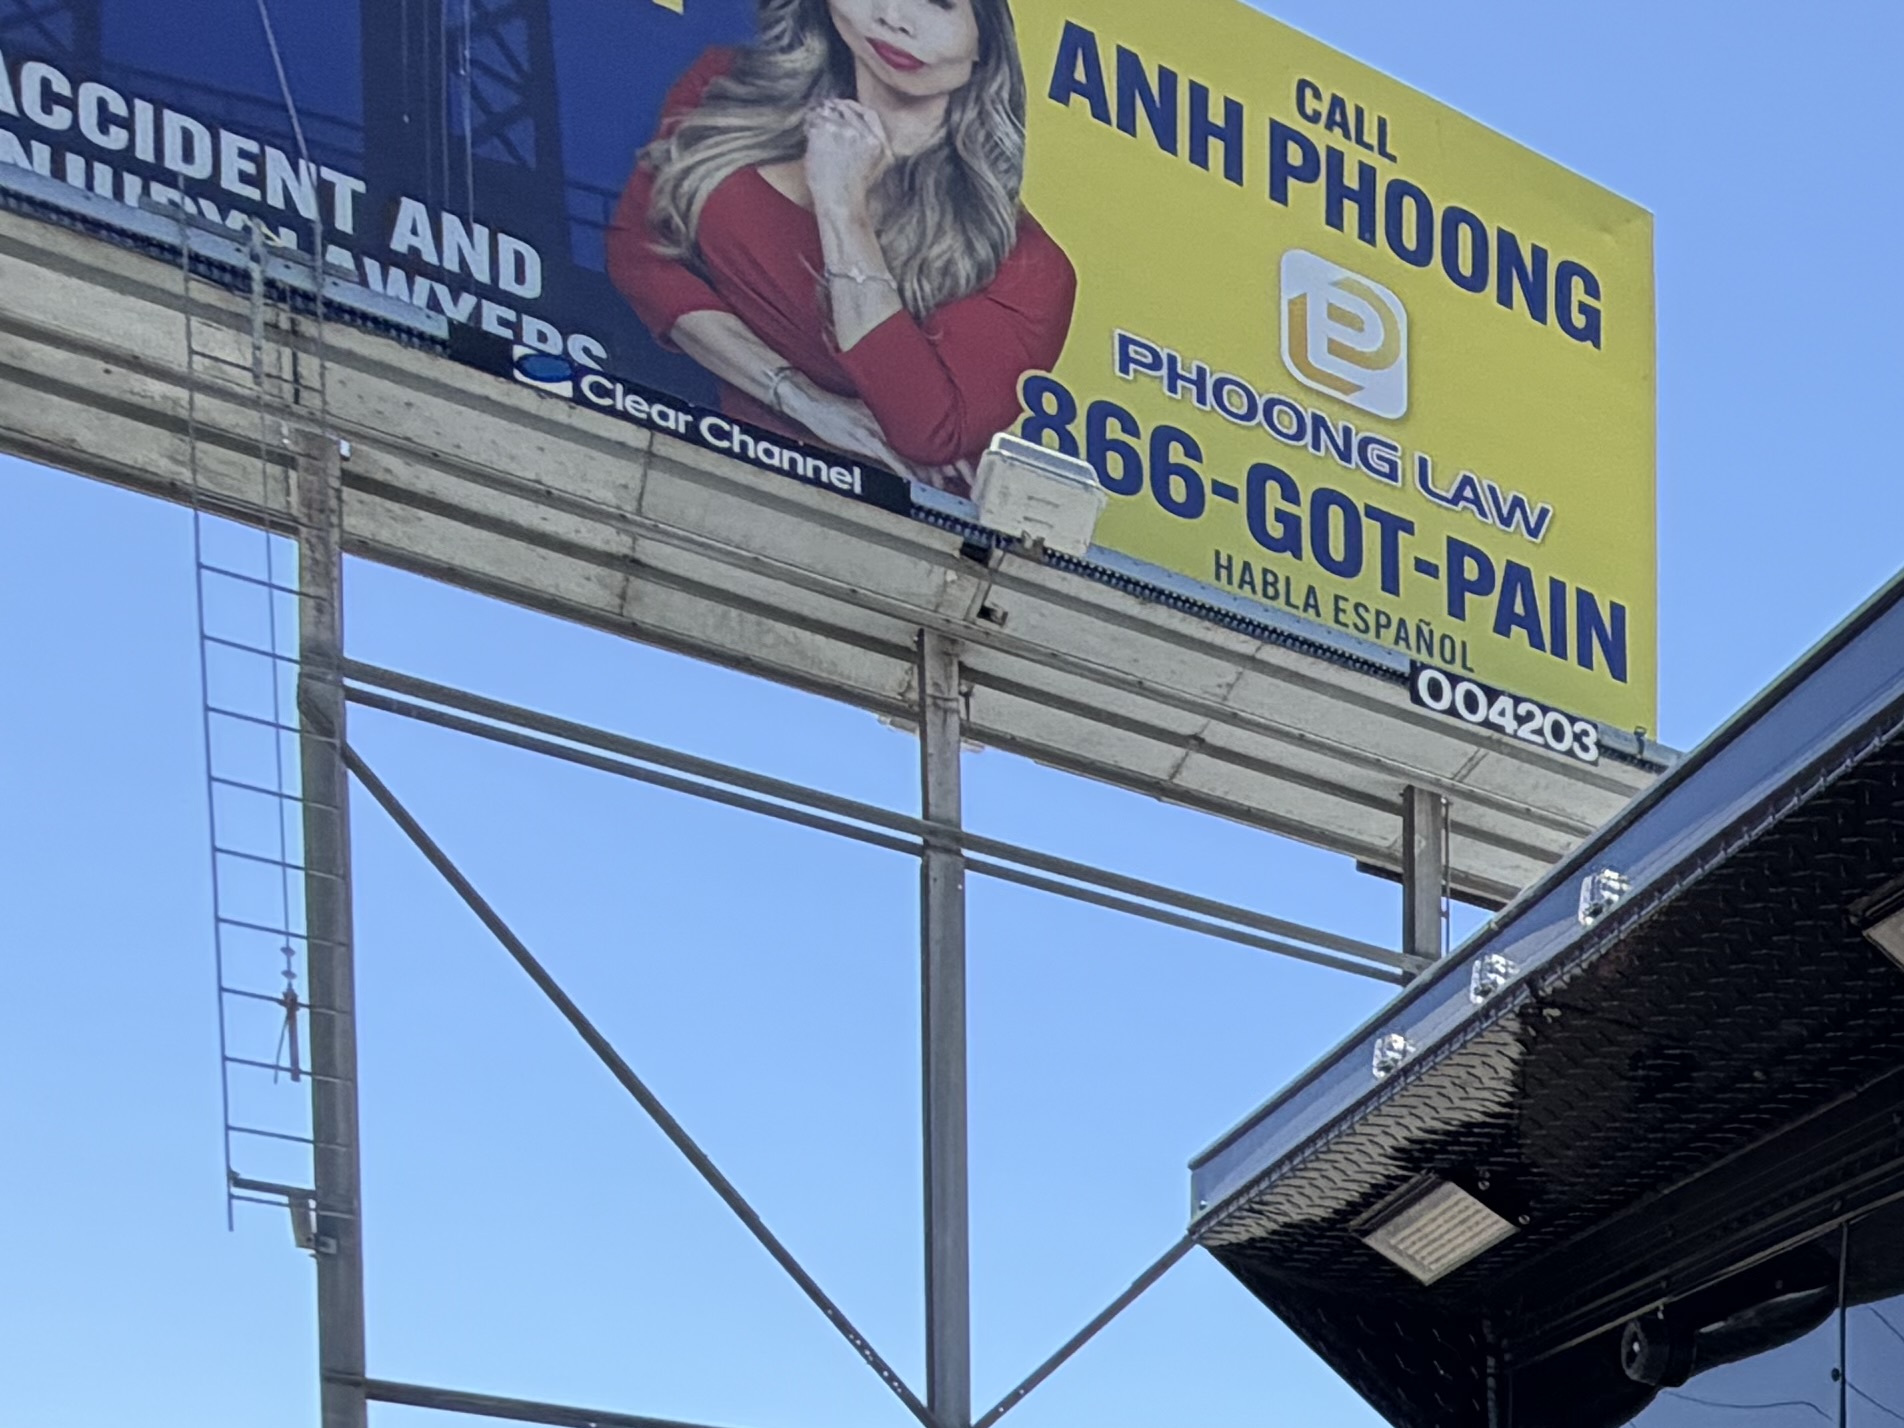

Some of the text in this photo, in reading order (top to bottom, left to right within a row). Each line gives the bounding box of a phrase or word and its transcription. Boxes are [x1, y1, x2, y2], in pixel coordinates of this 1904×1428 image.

[1296, 78, 1398, 163] CALL
[1047, 19, 1602, 350] ANH PHOONG
[390, 196, 542, 299] AND
[580, 374, 863, 496] Clear Channel
[1113, 329, 1552, 542] PHOONG LAW
[1020, 375, 1628, 684] 866-GOT-PAIN
[1214, 549, 1475, 673] HABLA ESPAÑOL
[1417, 668, 1599, 762] 004203
